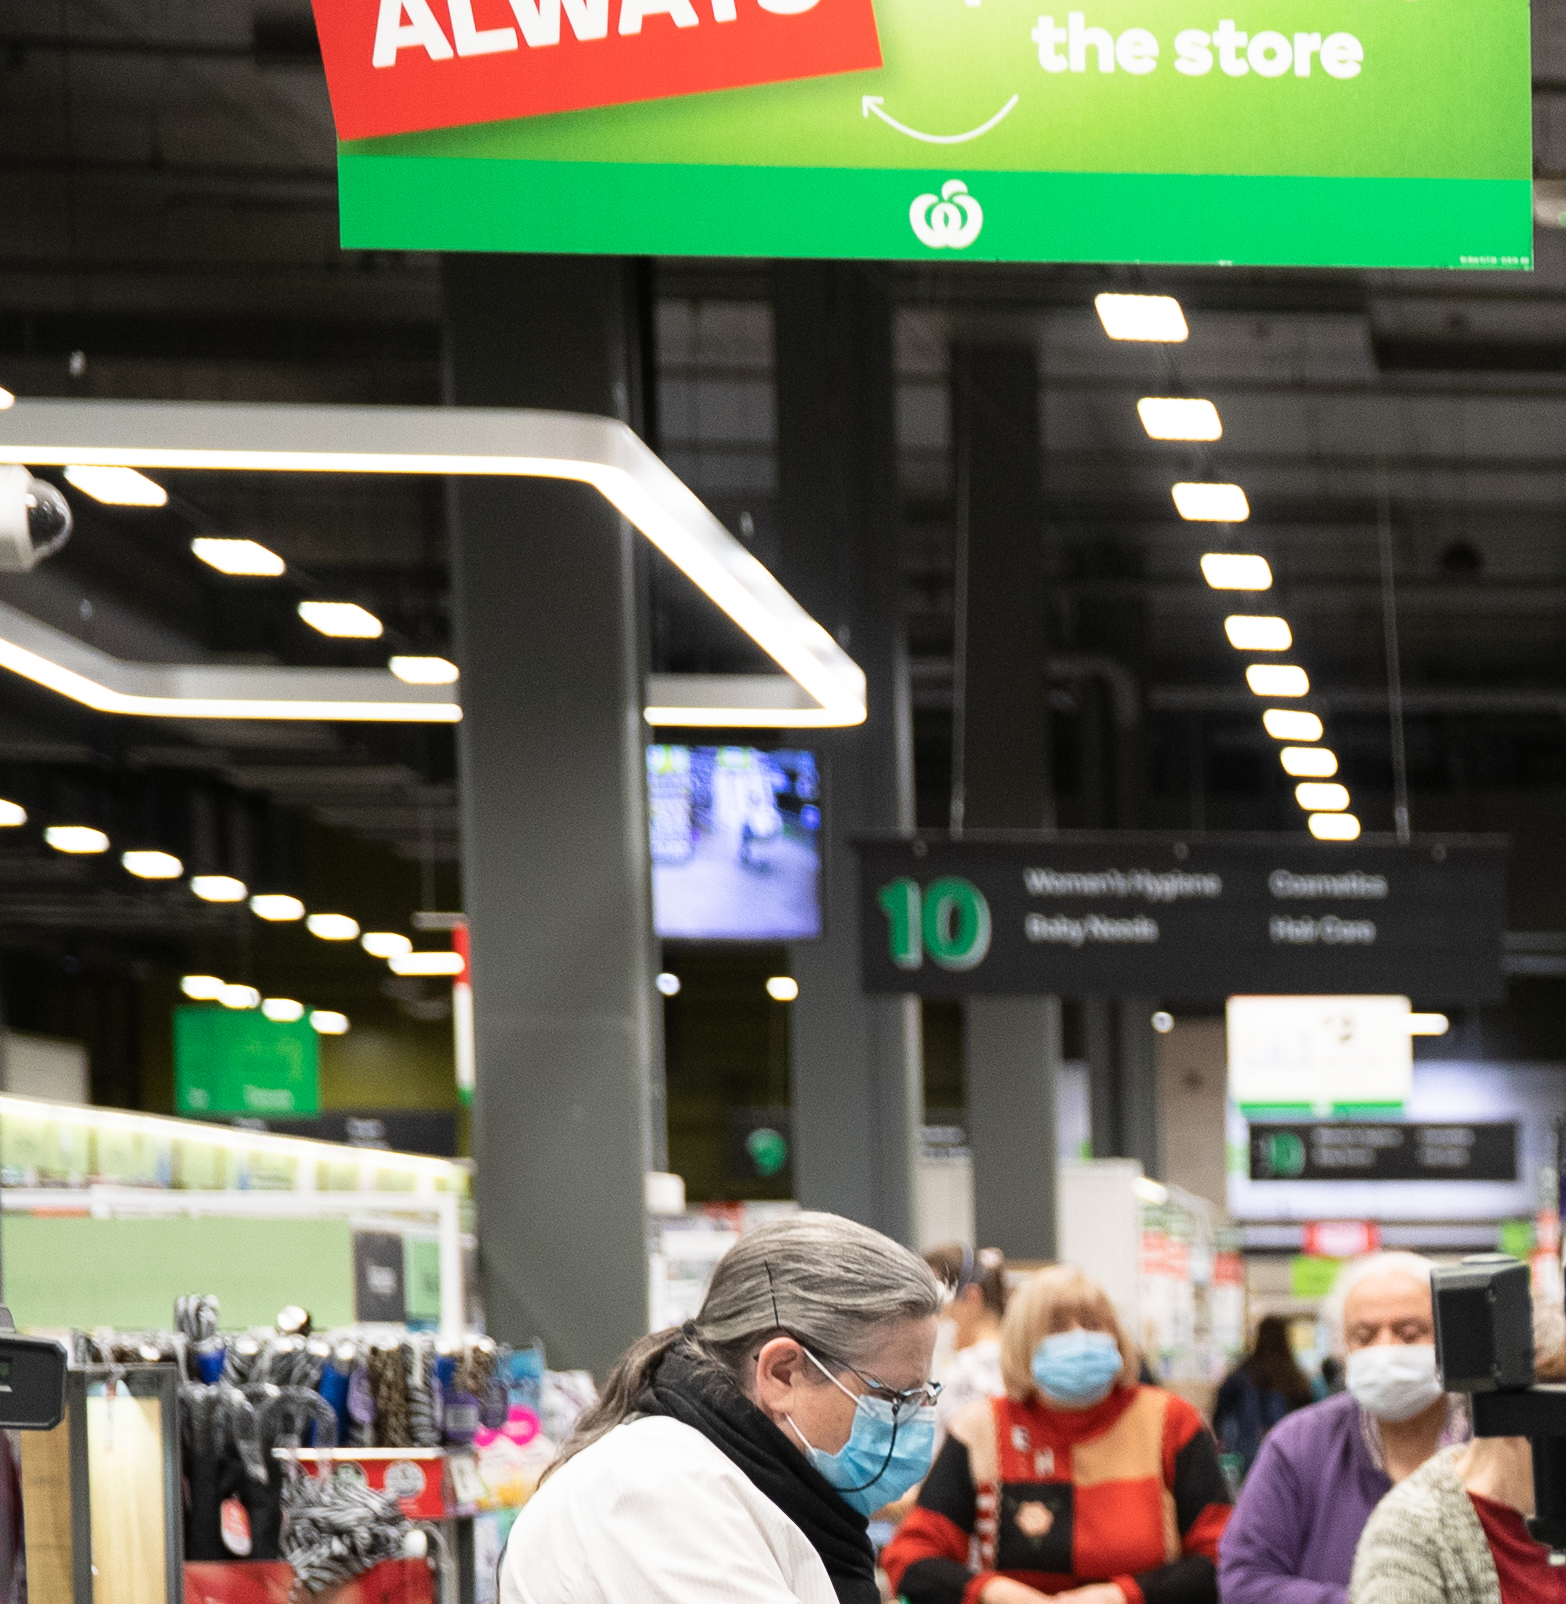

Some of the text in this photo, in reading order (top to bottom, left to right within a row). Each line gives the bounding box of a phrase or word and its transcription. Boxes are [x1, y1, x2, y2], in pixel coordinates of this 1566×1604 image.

[372, 0, 822, 69] ALWA
[1031, 12, 1364, 80] the store
[877, 876, 992, 971] 10
[1267, 868, 1390, 899] Cosmetics
[1023, 912, 1086, 946] Baby
